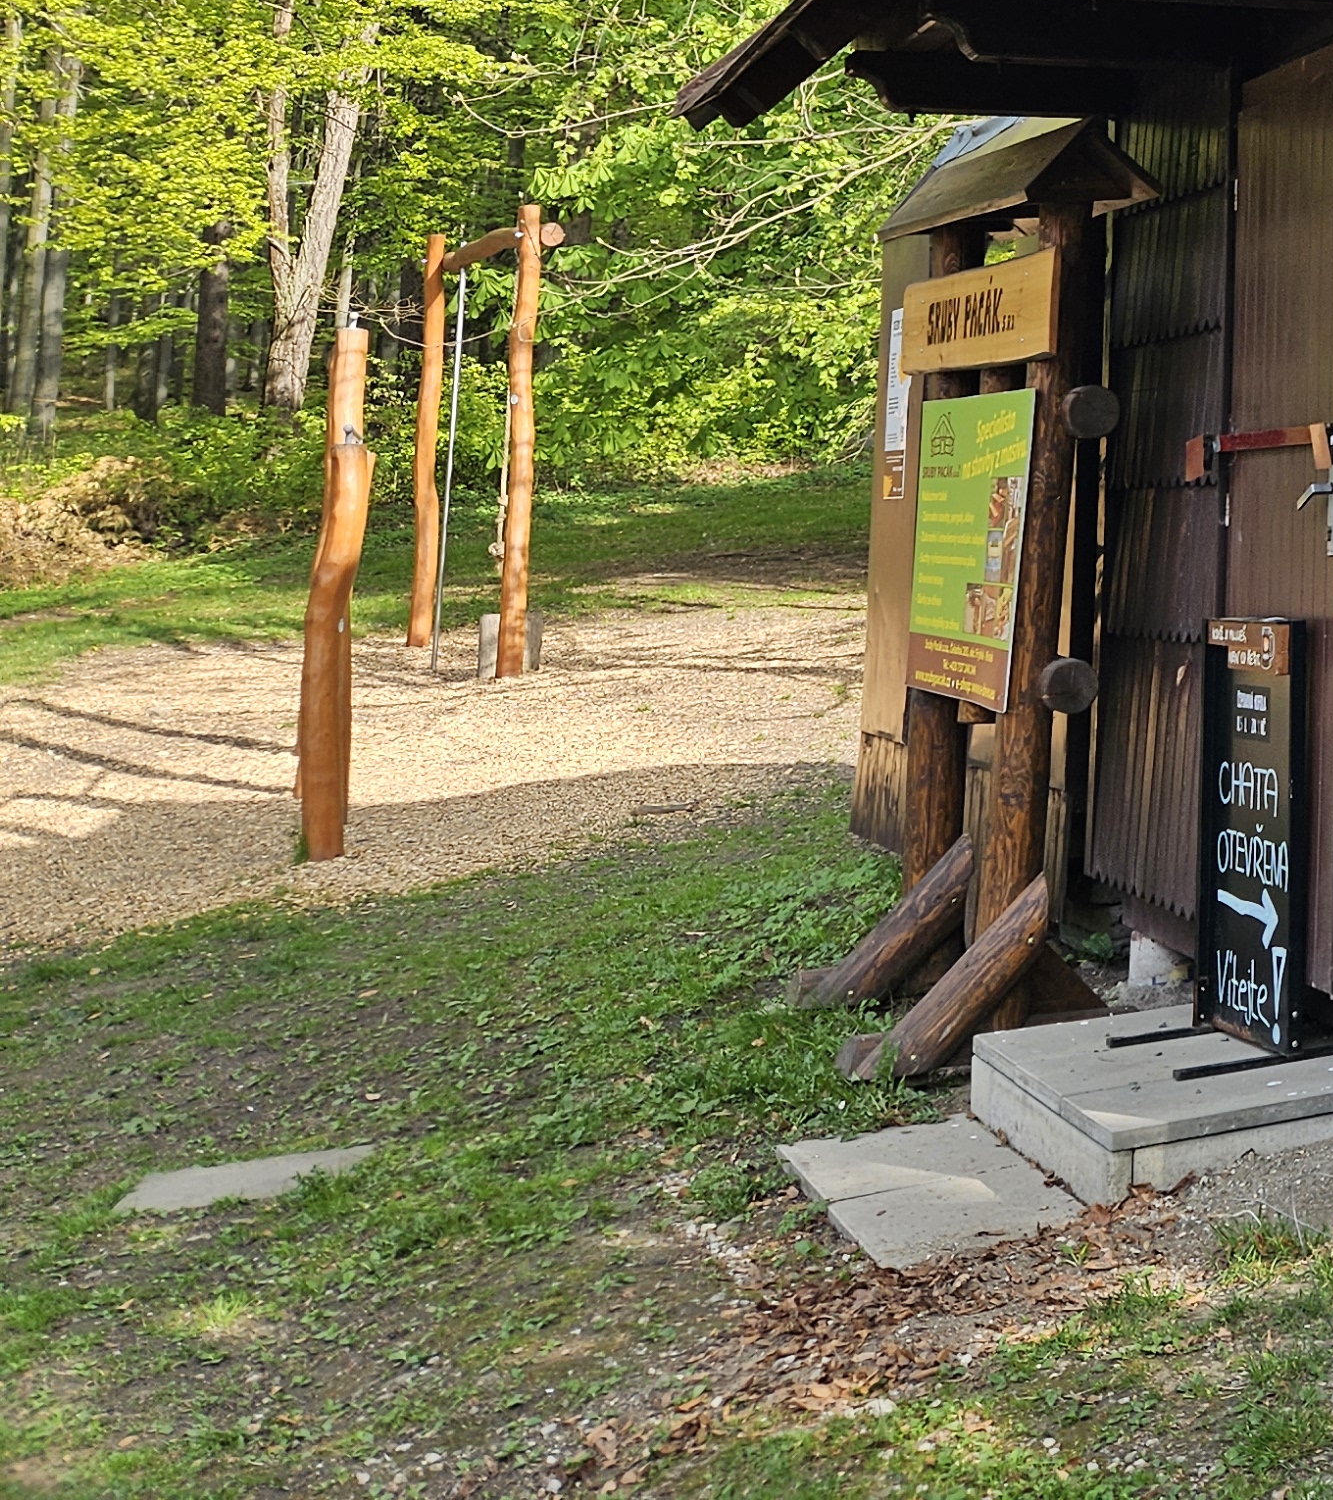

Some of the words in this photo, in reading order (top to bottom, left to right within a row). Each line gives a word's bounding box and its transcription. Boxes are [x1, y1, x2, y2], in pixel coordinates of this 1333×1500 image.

[927, 297, 960, 346] SRUBY
[1218, 761, 1279, 818] CHATA
[1216, 824, 1288, 893] OTEVŘENA
